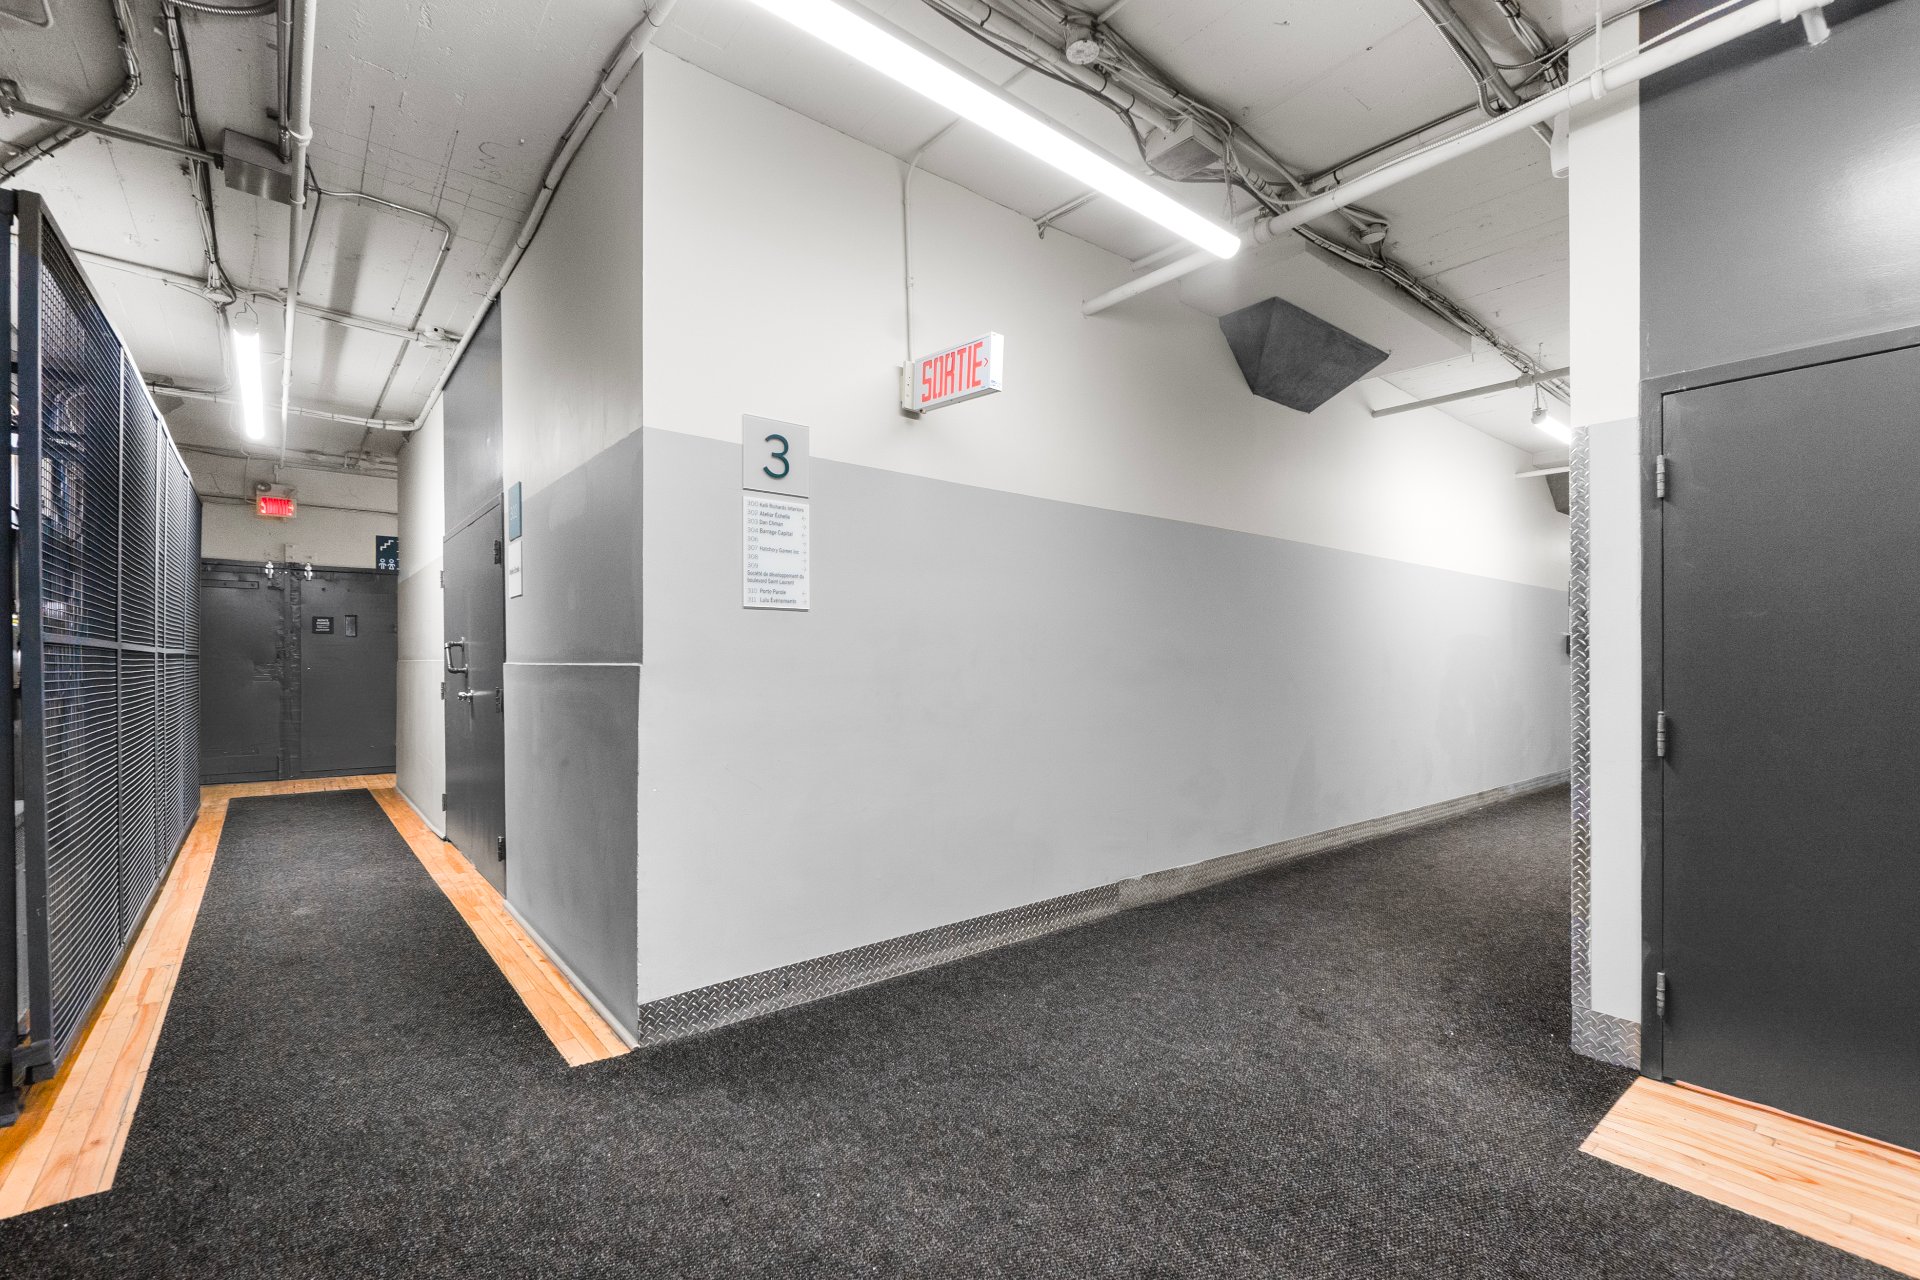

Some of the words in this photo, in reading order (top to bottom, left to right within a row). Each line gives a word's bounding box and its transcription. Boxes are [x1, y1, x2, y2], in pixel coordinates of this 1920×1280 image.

[921, 341, 983, 403] SORTIE
[763, 434, 790, 480] 3
[760, 528, 777, 536] Barrage
